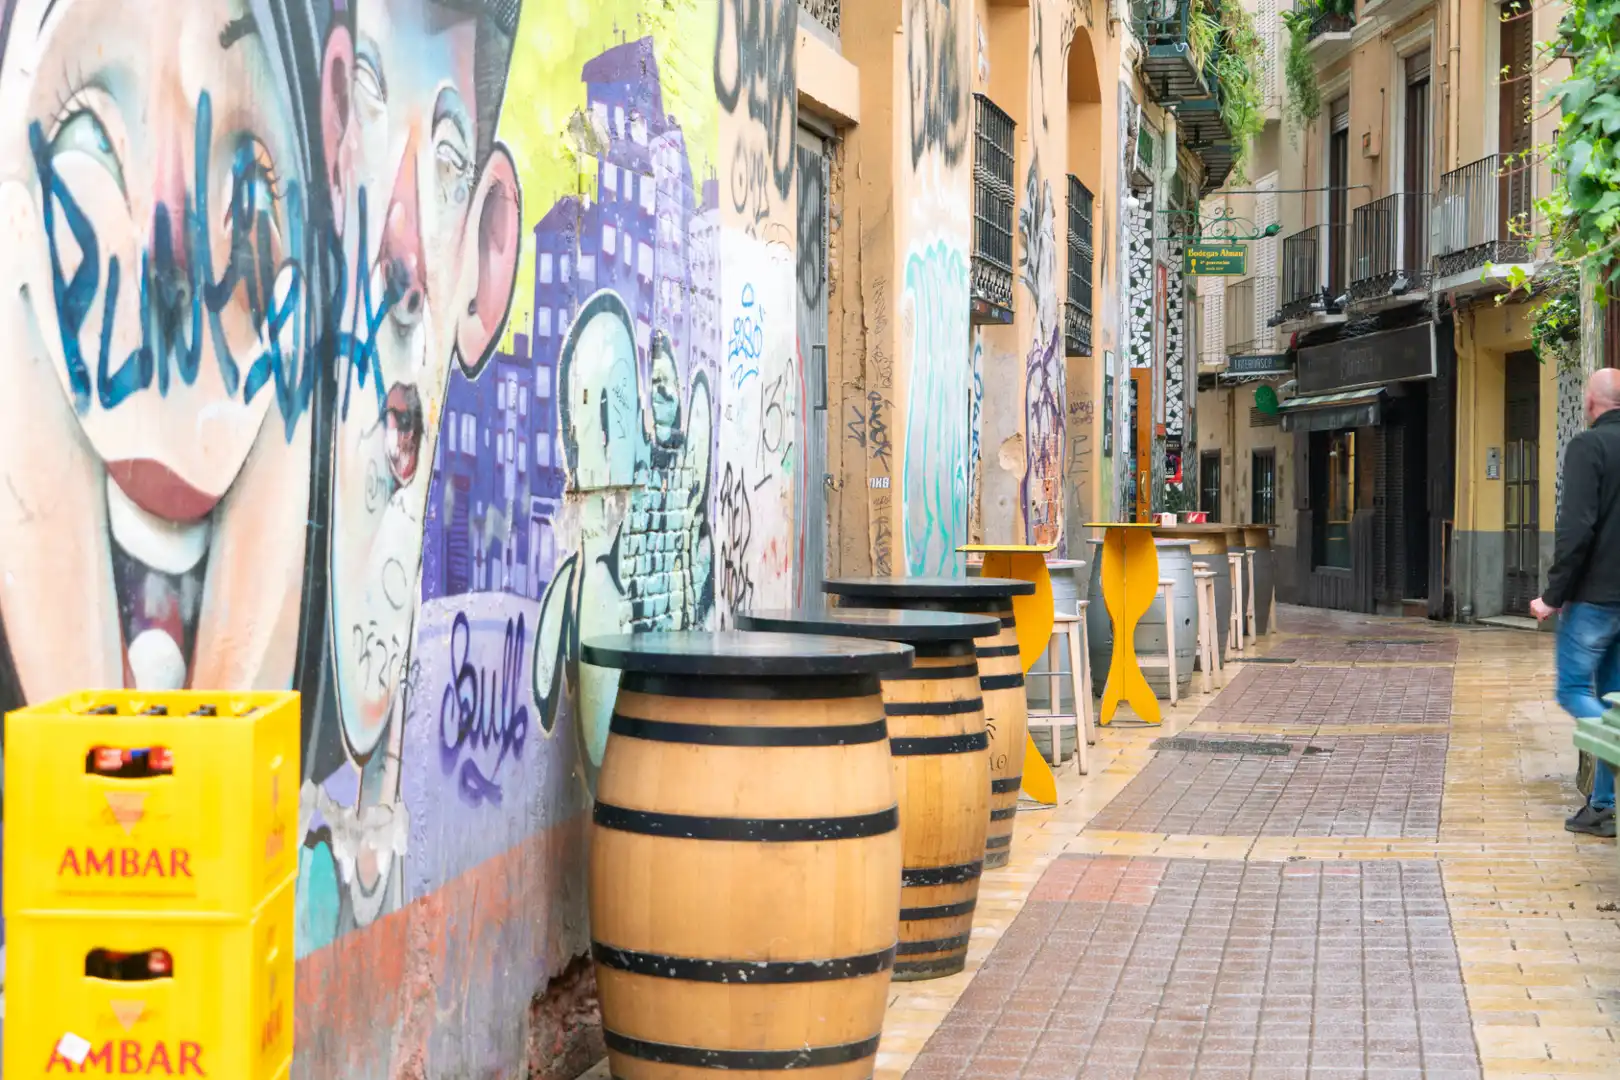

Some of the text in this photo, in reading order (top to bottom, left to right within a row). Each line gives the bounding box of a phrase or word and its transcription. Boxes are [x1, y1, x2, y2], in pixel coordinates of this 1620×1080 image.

[1188, 248, 1244, 259] Bodegas Almau
[58, 847, 193, 878] AMBAR
[44, 1038, 207, 1077] AMBAR
